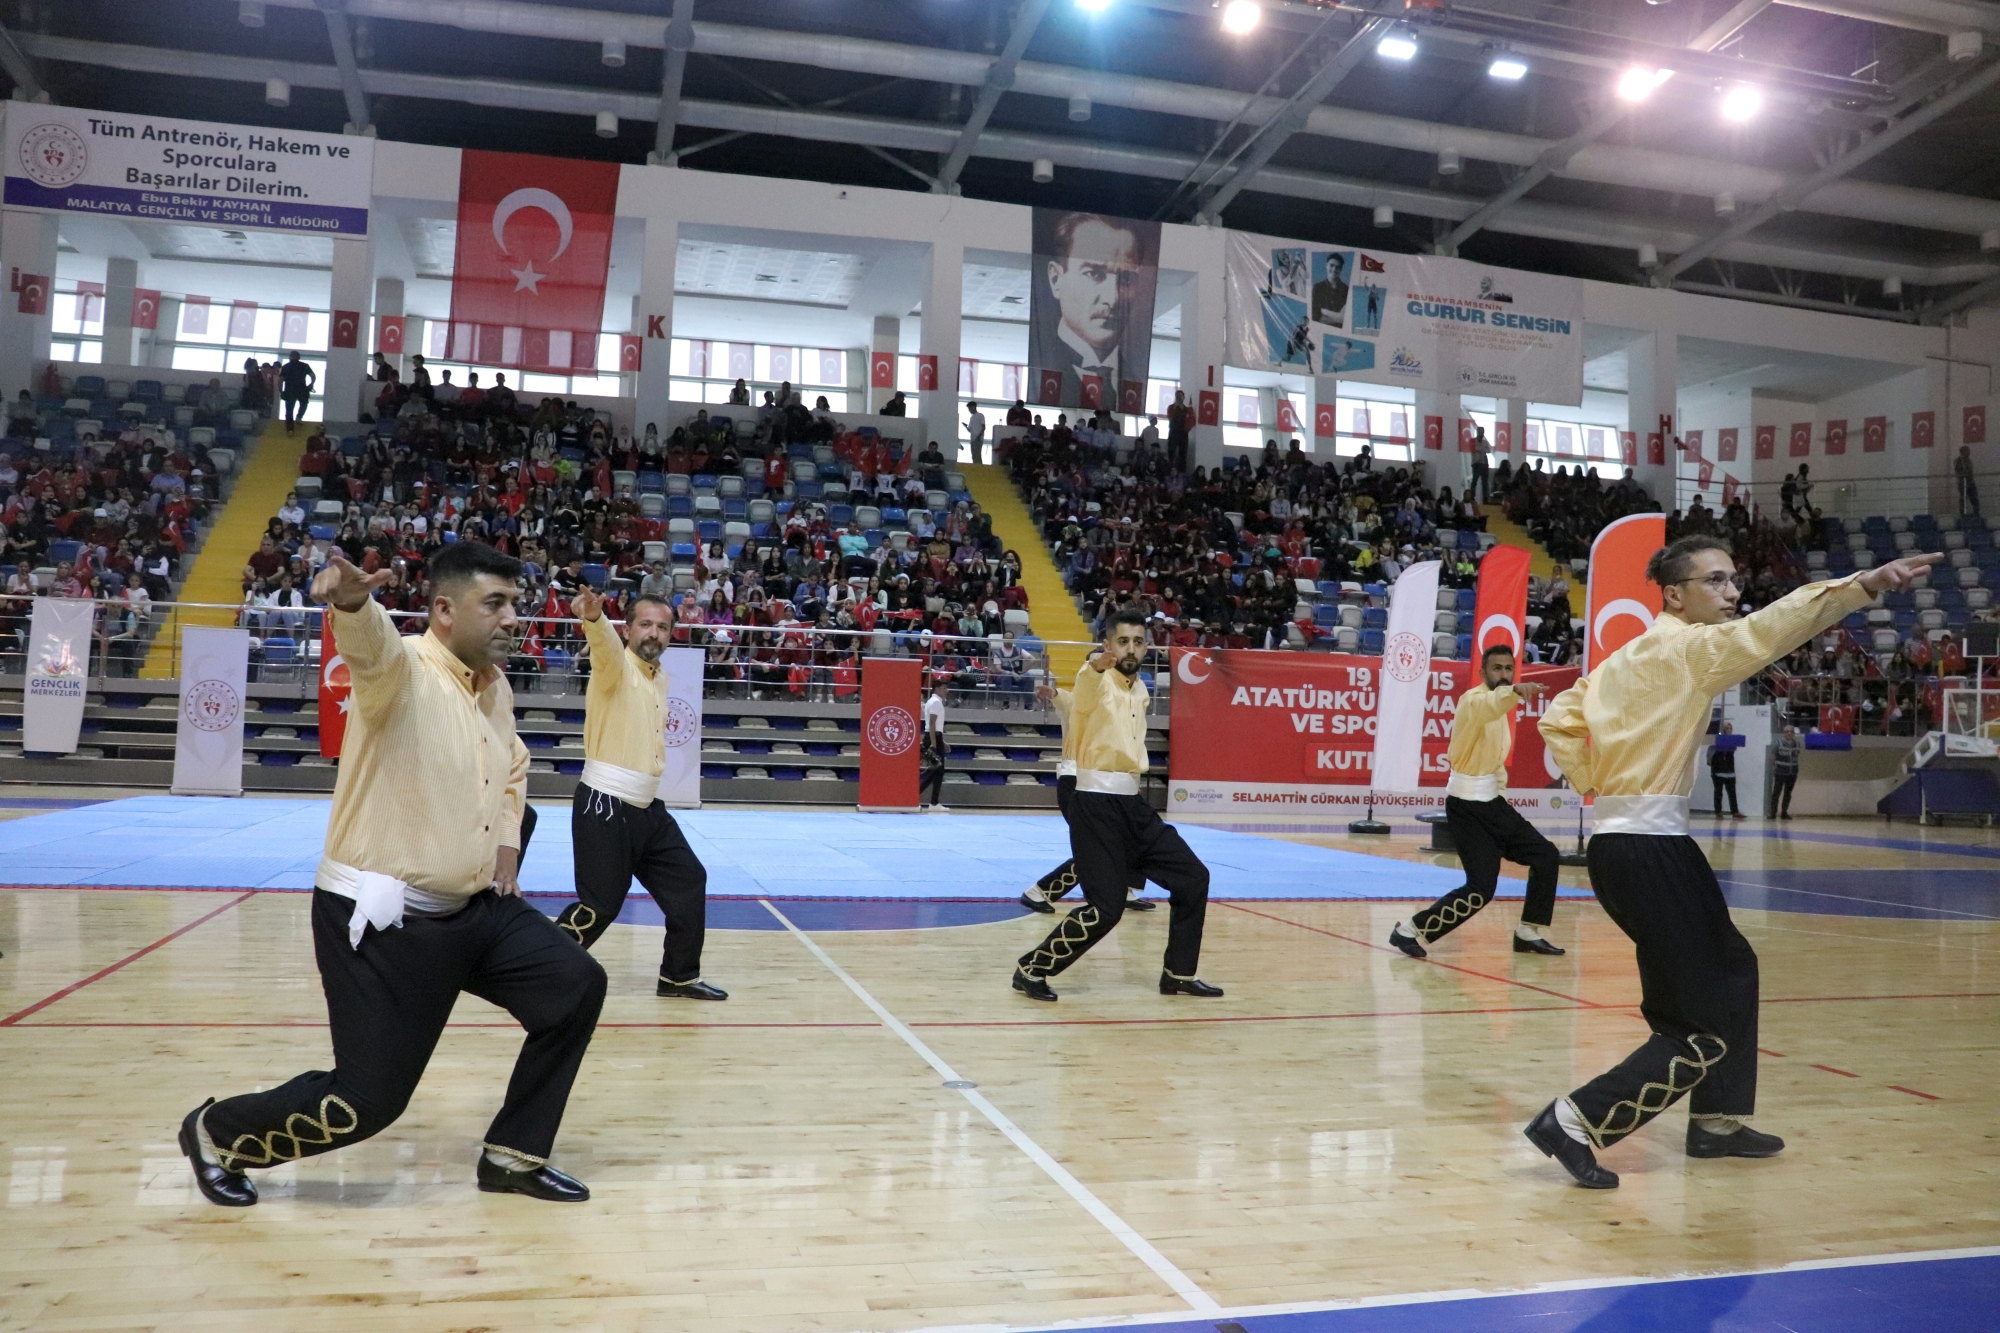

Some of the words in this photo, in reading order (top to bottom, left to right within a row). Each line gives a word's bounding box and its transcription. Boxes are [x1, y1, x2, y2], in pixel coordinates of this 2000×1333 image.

[88, 118, 134, 139] Tüm
[141, 125, 242, 152] Antrenör,
[248, 135, 320, 156] Hakem
[326, 145, 350, 158] ve
[163, 148, 277, 173] Sporculara
[126, 167, 220, 190] Başarılar
[226, 176, 309, 198] Dilerim.
[67, 198, 132, 213] MALATYA
[137, 205, 196, 218] GENÇLİK
[201, 210, 218, 220] VE
[223, 211, 259, 223] SPOR
[263, 213, 275, 225] İL
[279, 215, 340, 229] MÜDÜRÜ
[141, 193, 169, 204] Ebu
[171, 195, 208, 207] Bekir
[213, 199, 271, 213] KAYHAN
[1406, 300, 1486, 324] GURUR
[648, 314, 666, 340] K
[1659, 413, 1672, 435] H
[1346, 667, 1372, 687] 19
[1290, 713, 1325, 733] VE
[1331, 714, 1378, 736] SPO
[1232, 790, 1307, 804] SELAHATTİN
[1311, 792, 1360, 805] GÜRKAN
[1363, 793, 1435, 808] BÜYÜKŞEHİR
